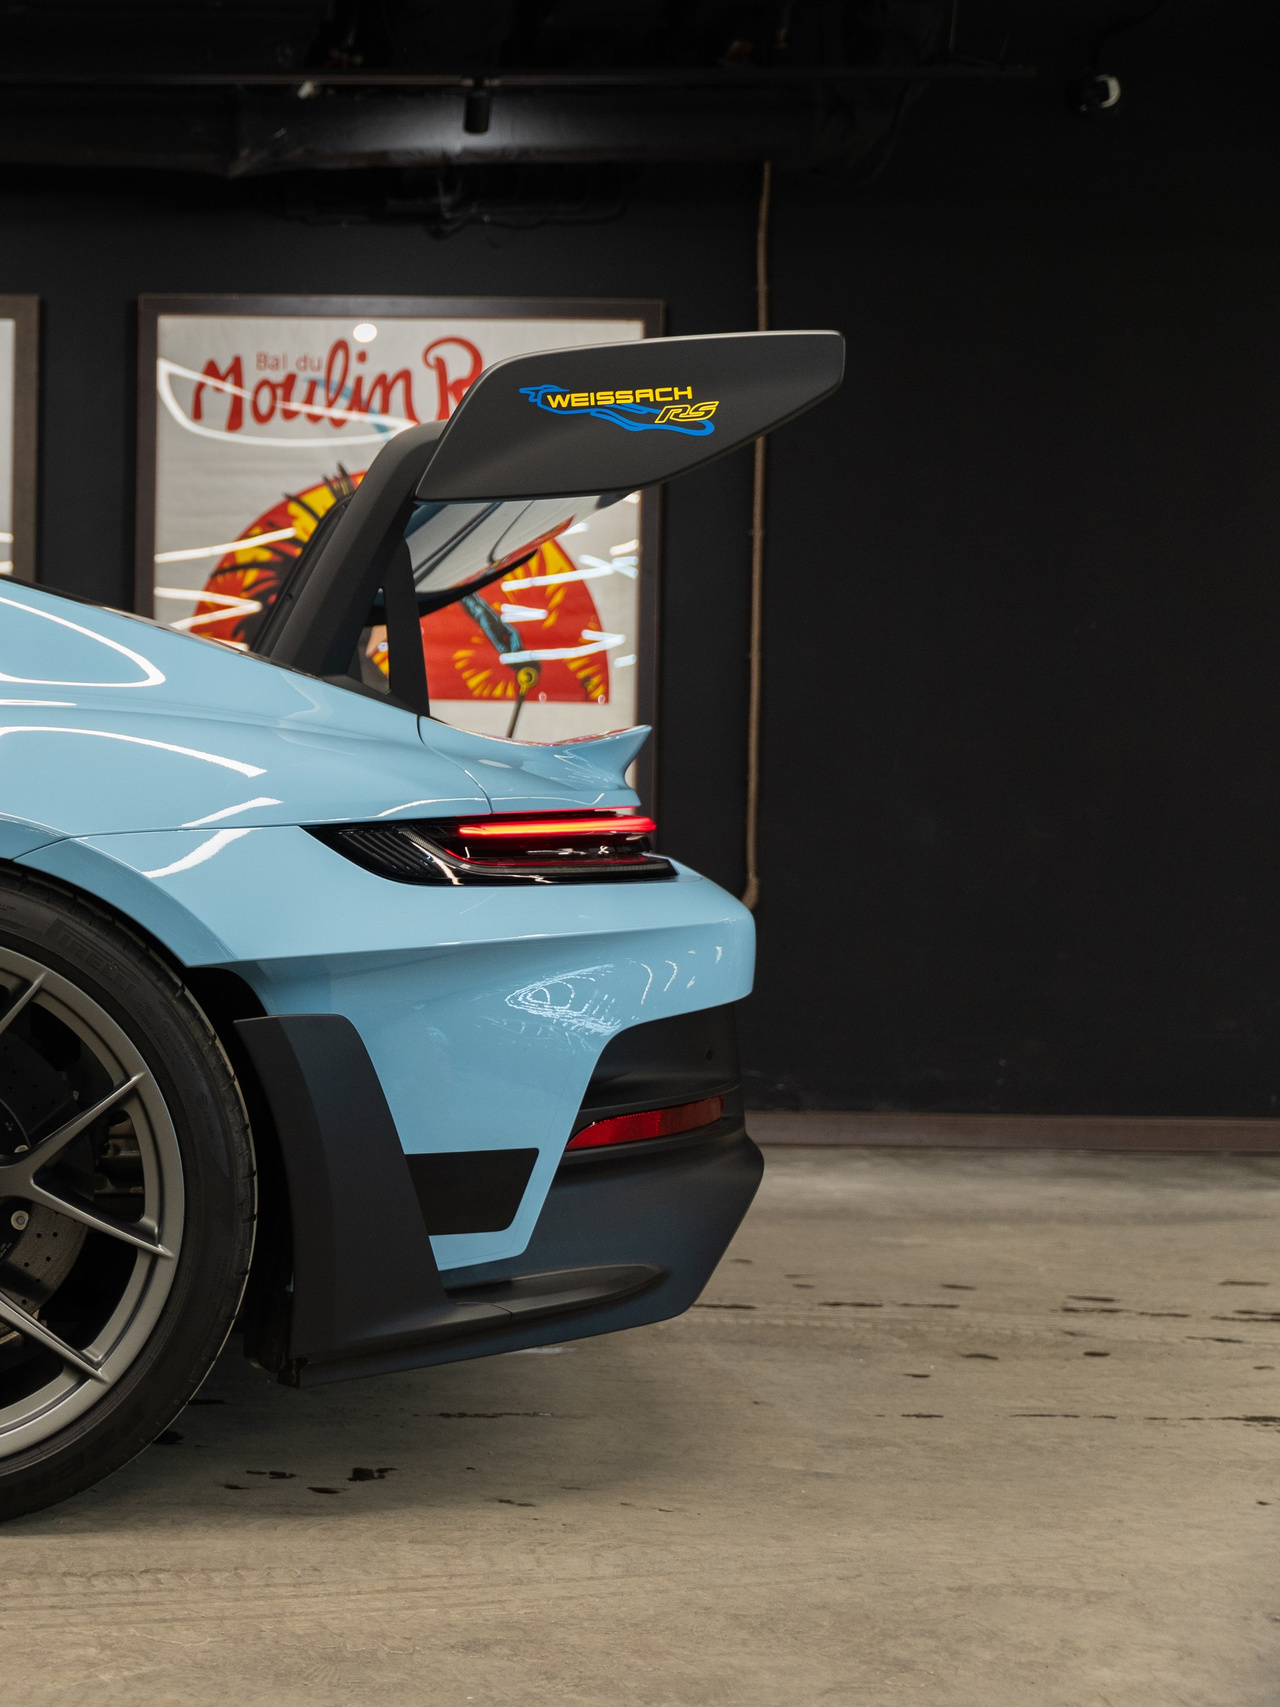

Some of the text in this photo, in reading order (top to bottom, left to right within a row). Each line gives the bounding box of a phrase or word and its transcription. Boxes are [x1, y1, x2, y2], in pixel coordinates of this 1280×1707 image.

[256, 351, 322, 372] Bal du
[191, 336, 483, 432] Moulin R
[547, 386, 693, 408] WEISSACH
[654, 400, 720, 424] RS
